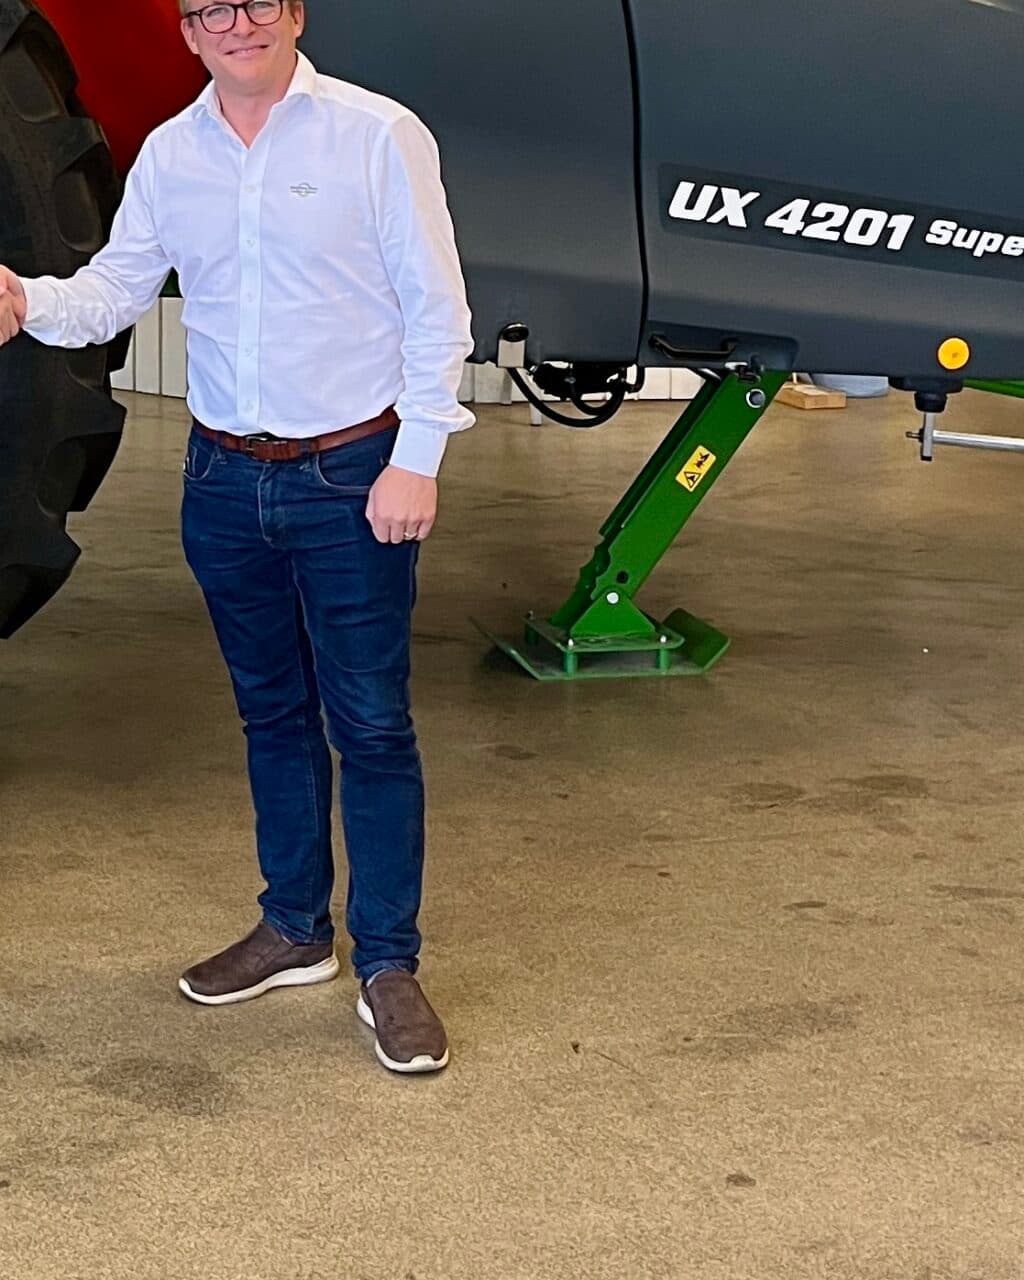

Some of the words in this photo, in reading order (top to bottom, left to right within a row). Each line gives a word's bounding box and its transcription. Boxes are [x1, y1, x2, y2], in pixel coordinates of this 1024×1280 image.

[668, 181, 760, 228] UX
[764, 198, 915, 251] 4201
[925, 219, 1024, 258] Supe
